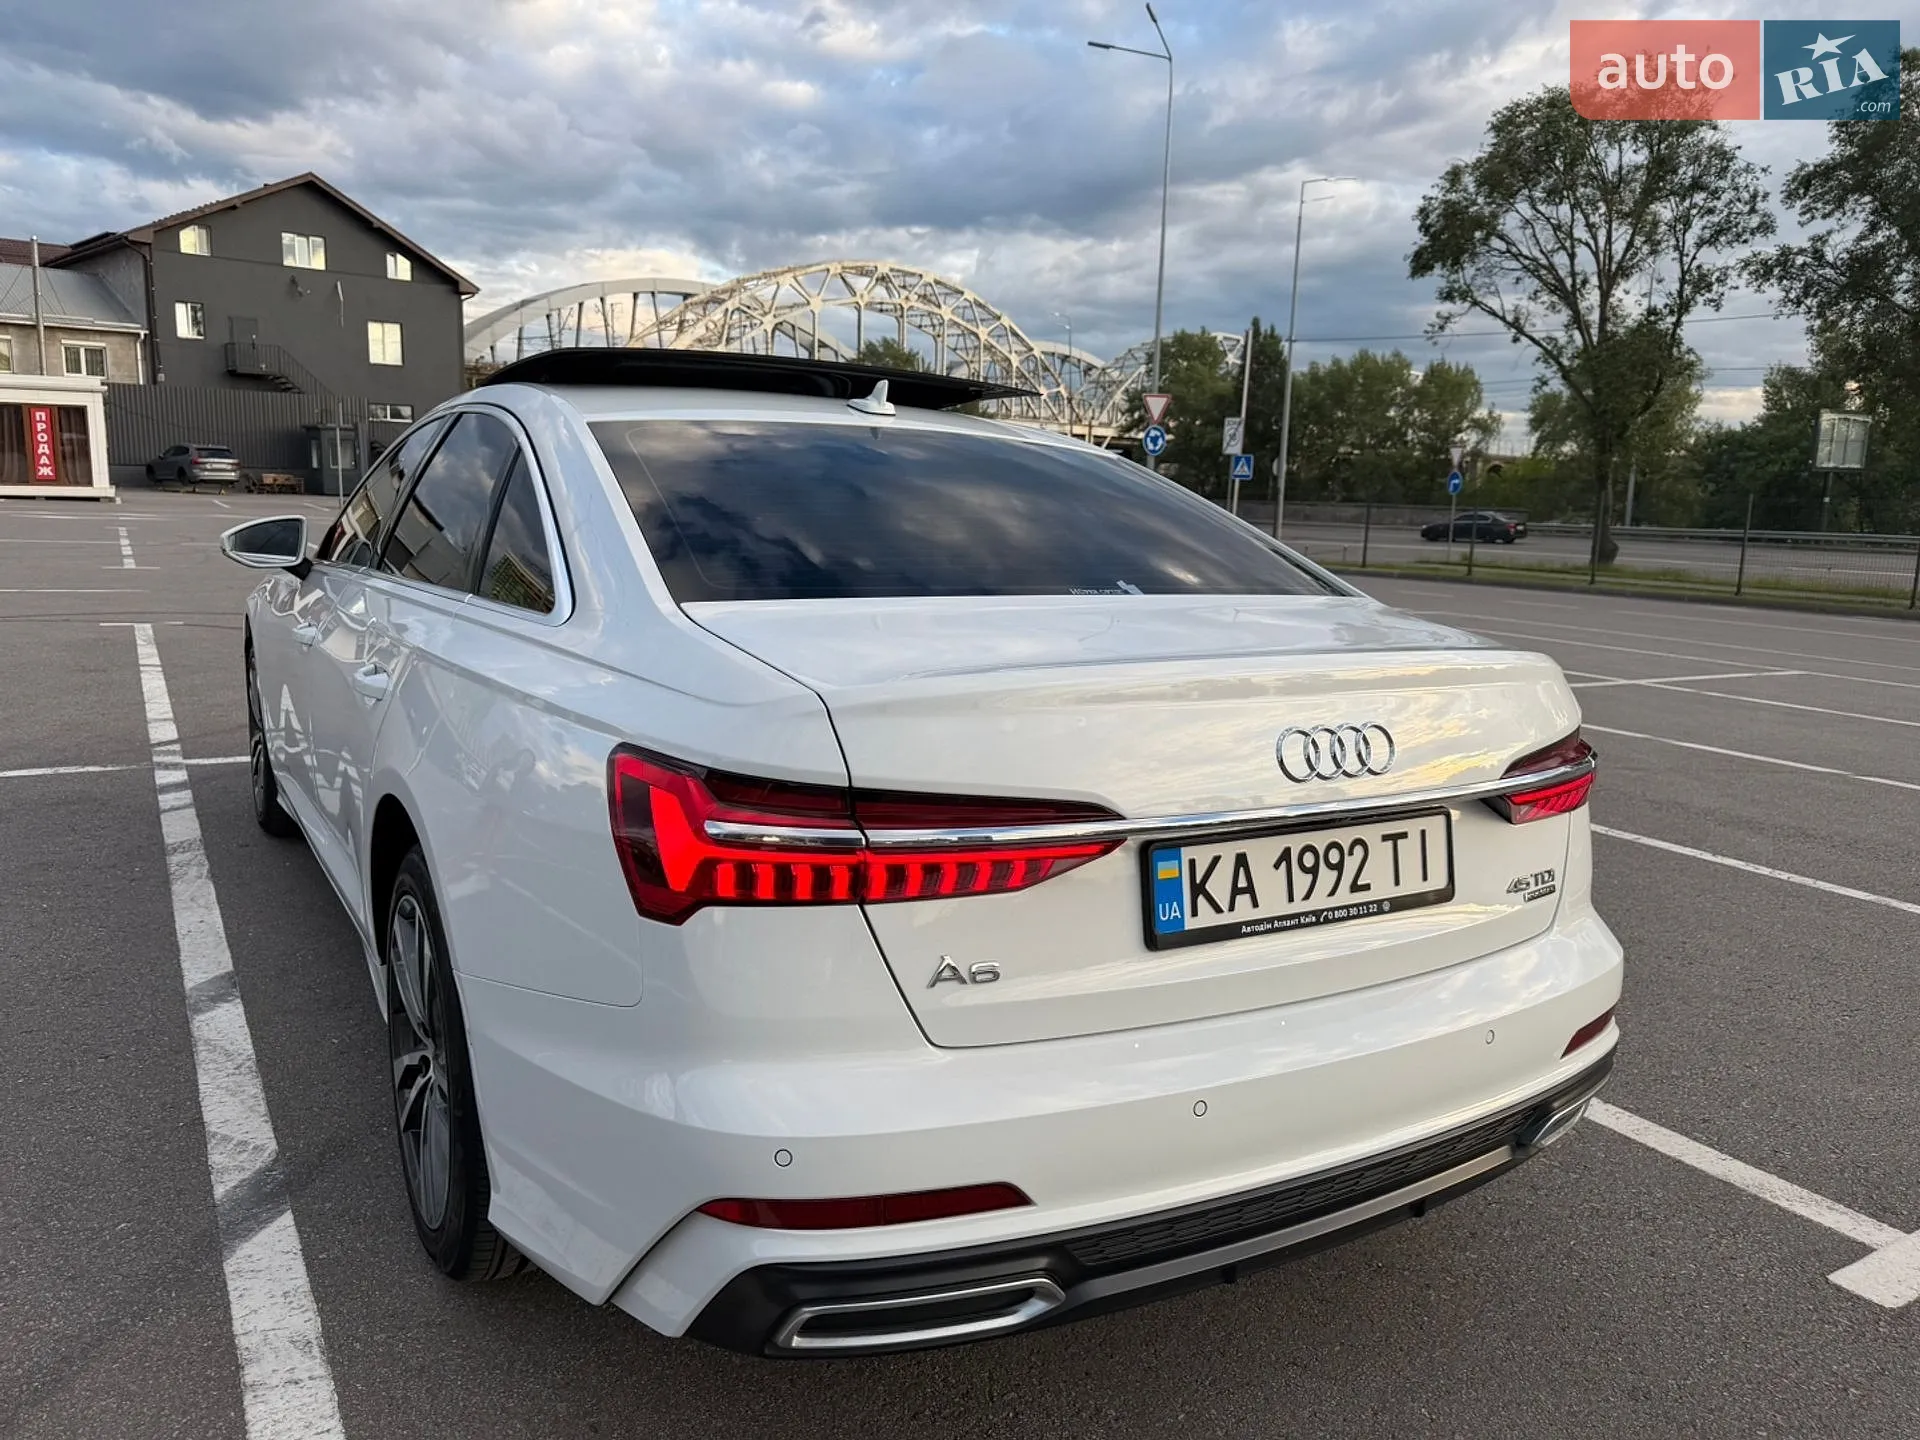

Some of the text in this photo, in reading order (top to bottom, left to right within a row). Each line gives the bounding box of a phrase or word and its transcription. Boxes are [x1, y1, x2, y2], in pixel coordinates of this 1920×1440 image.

[35, 411, 54, 476] ПРОДАЖ
[1188, 851, 1259, 918] KA
[1273, 837, 1371, 904] 1992
[1158, 901, 1182, 921] UA
[1334, 909, 1348, 919] 800
[1348, 906, 1358, 916] 30
[1359, 905, 1368, 914] 11
[1368, 904, 1378, 912] 22
[926, 955, 1001, 989] A6
